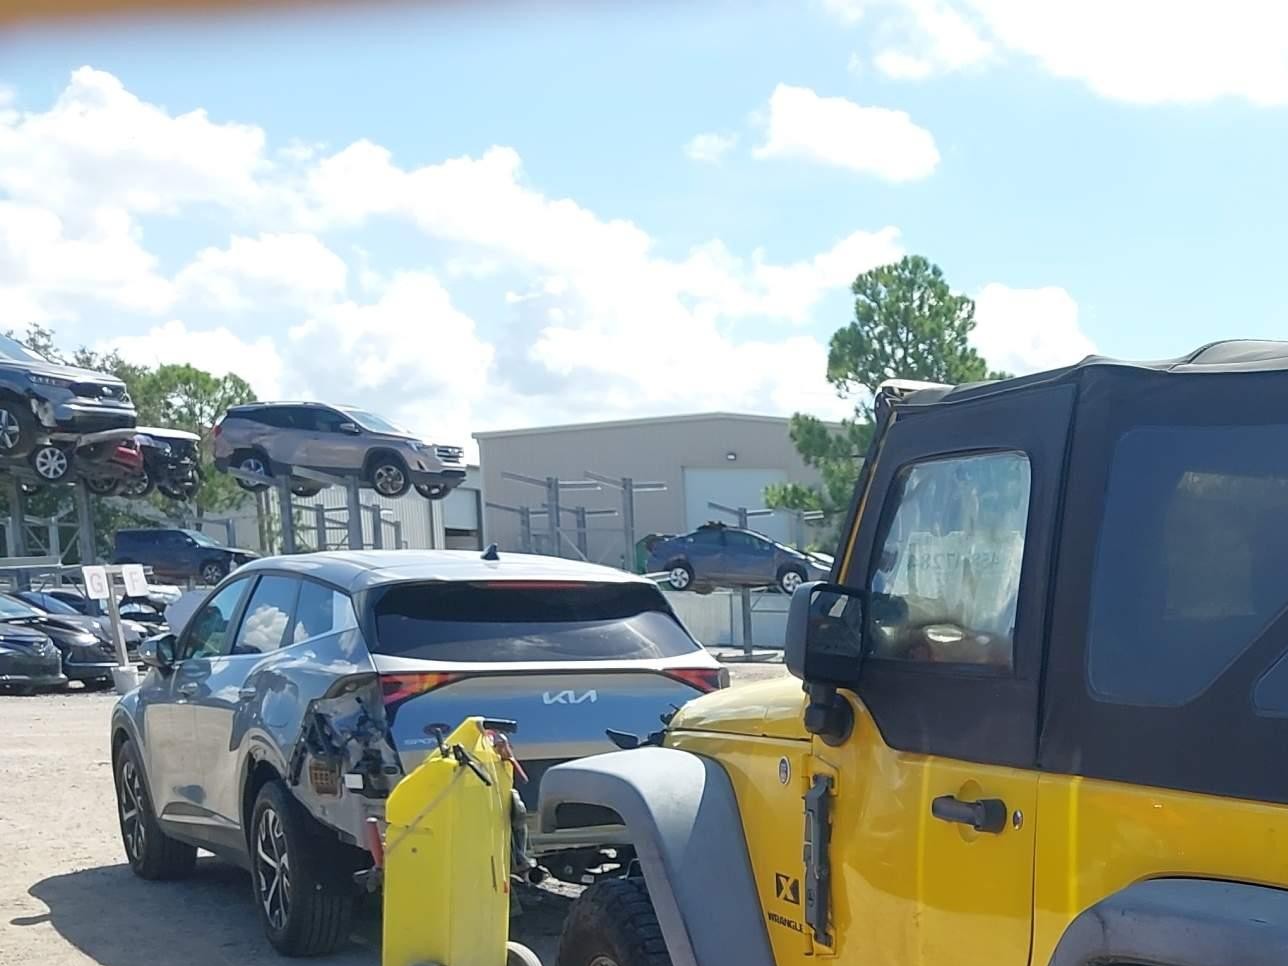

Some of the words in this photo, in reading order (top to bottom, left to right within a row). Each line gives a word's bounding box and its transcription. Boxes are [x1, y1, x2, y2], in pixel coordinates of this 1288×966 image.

[89, 572, 104, 593] G
[129, 571, 142, 592] F
[542, 689, 599, 705] KIA
[775, 872, 800, 905] X
[768, 911, 804, 933] WRANGLE
